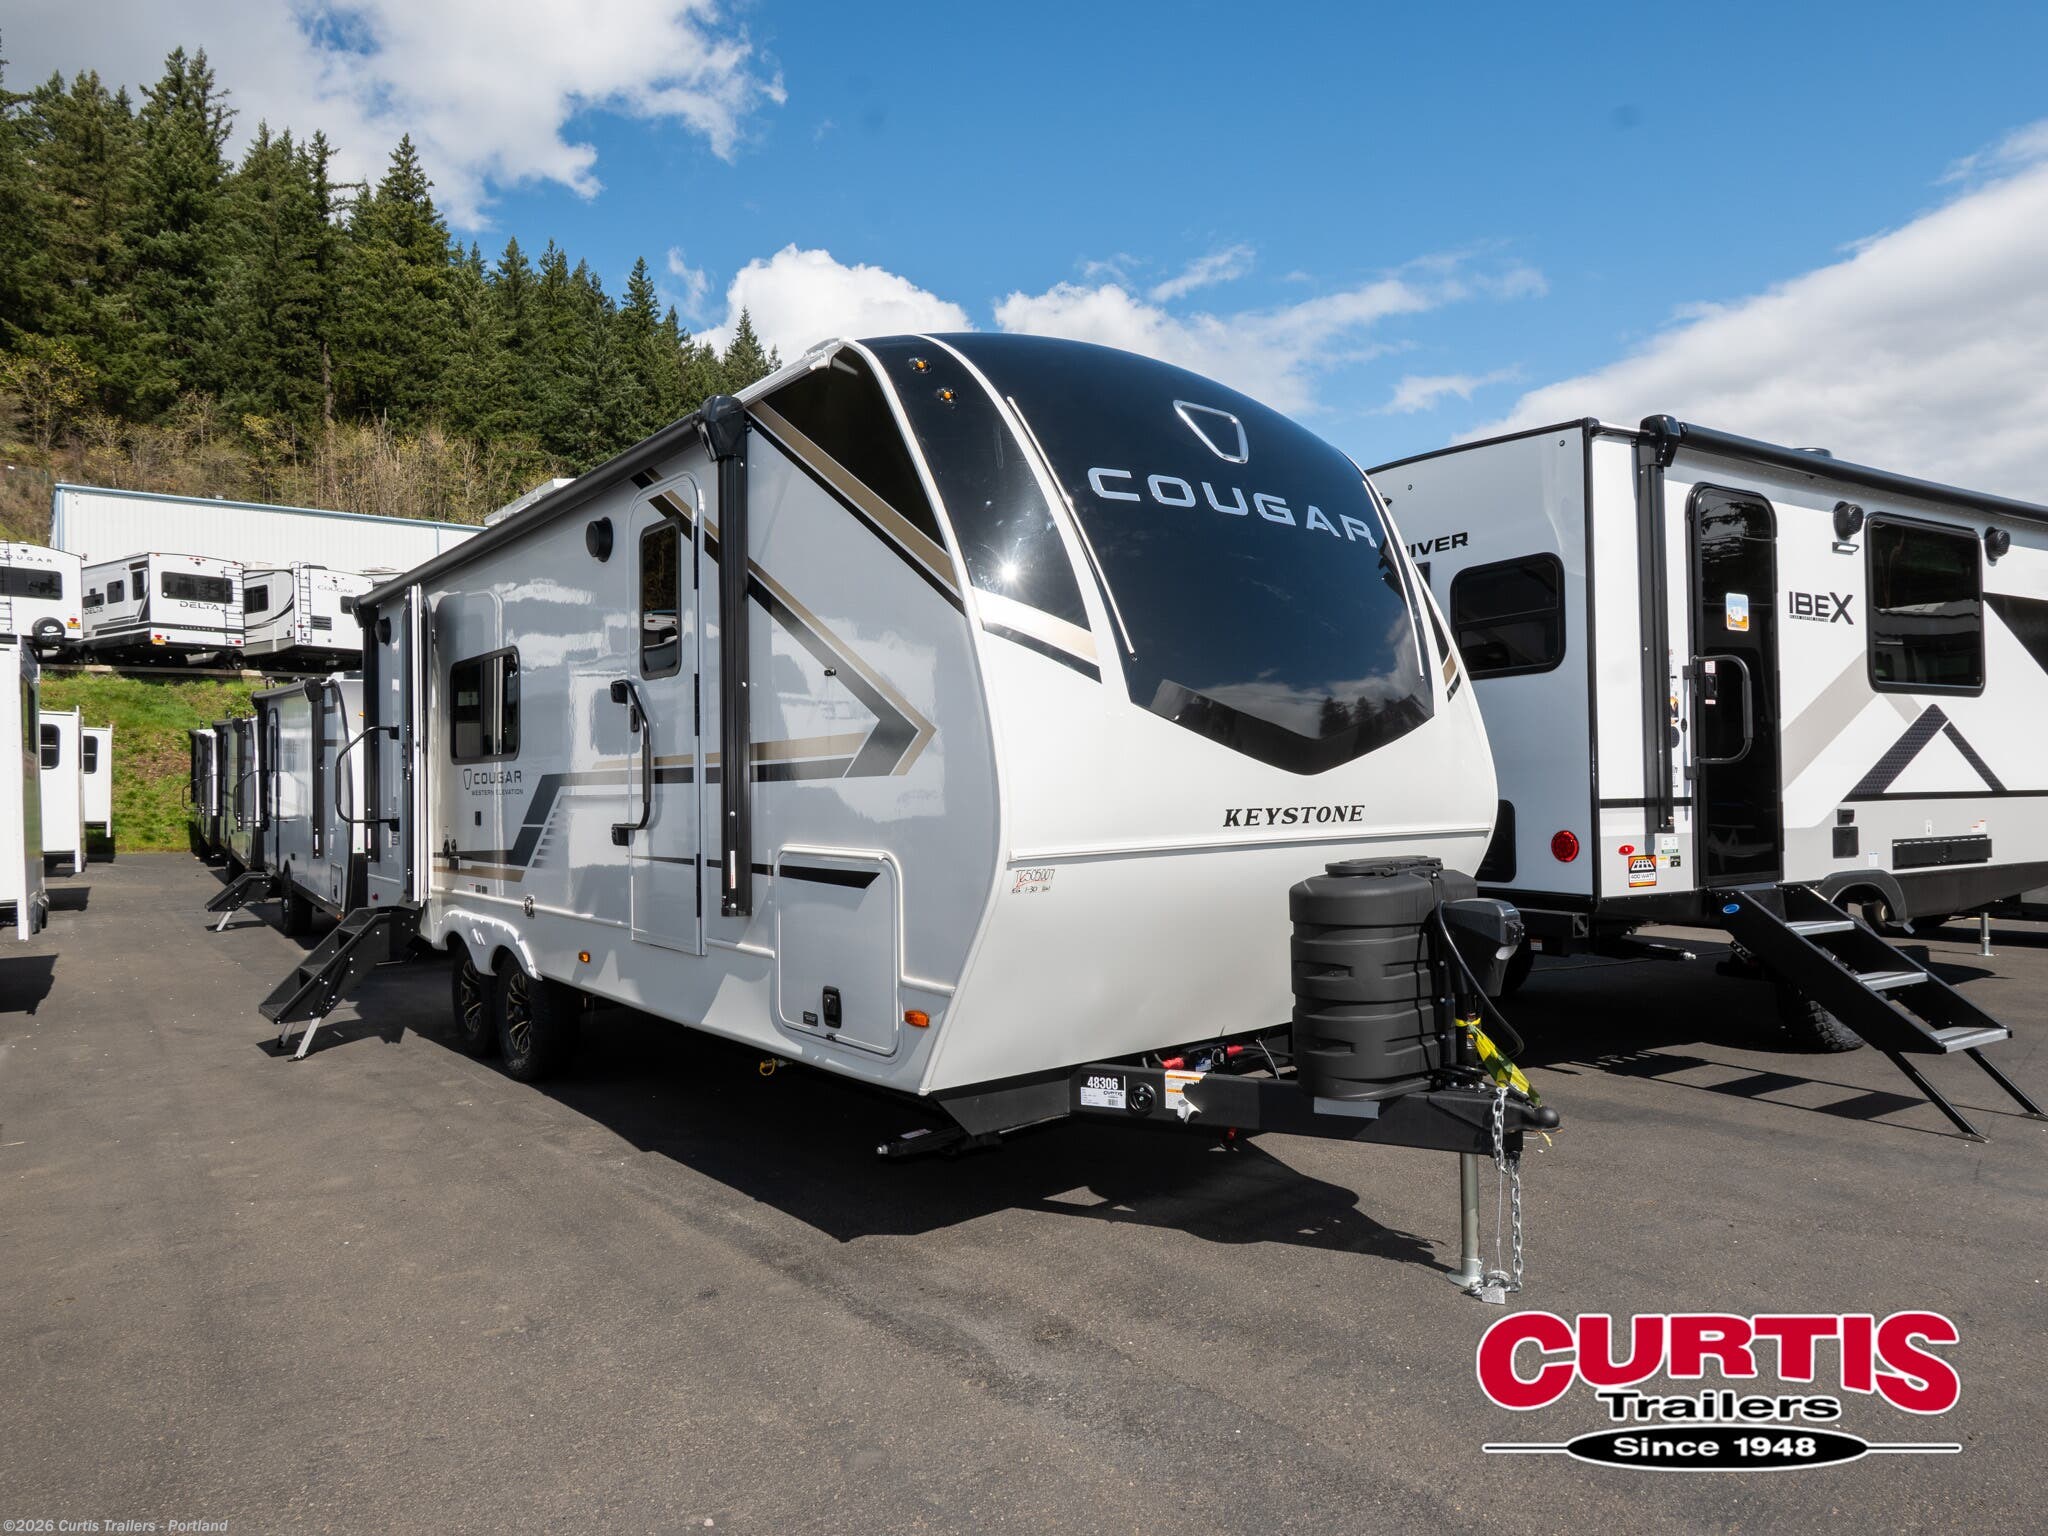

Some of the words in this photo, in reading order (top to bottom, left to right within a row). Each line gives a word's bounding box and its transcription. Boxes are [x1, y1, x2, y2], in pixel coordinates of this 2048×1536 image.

[1087, 467, 1377, 548] COUGAR
[179, 600, 220, 611] DELTA
[1788, 591, 1854, 625] IBEX
[473, 769, 522, 785] COUGAR
[1222, 804, 1366, 828] KEYSTONE
[1086, 1075, 1119, 1091] 48306
